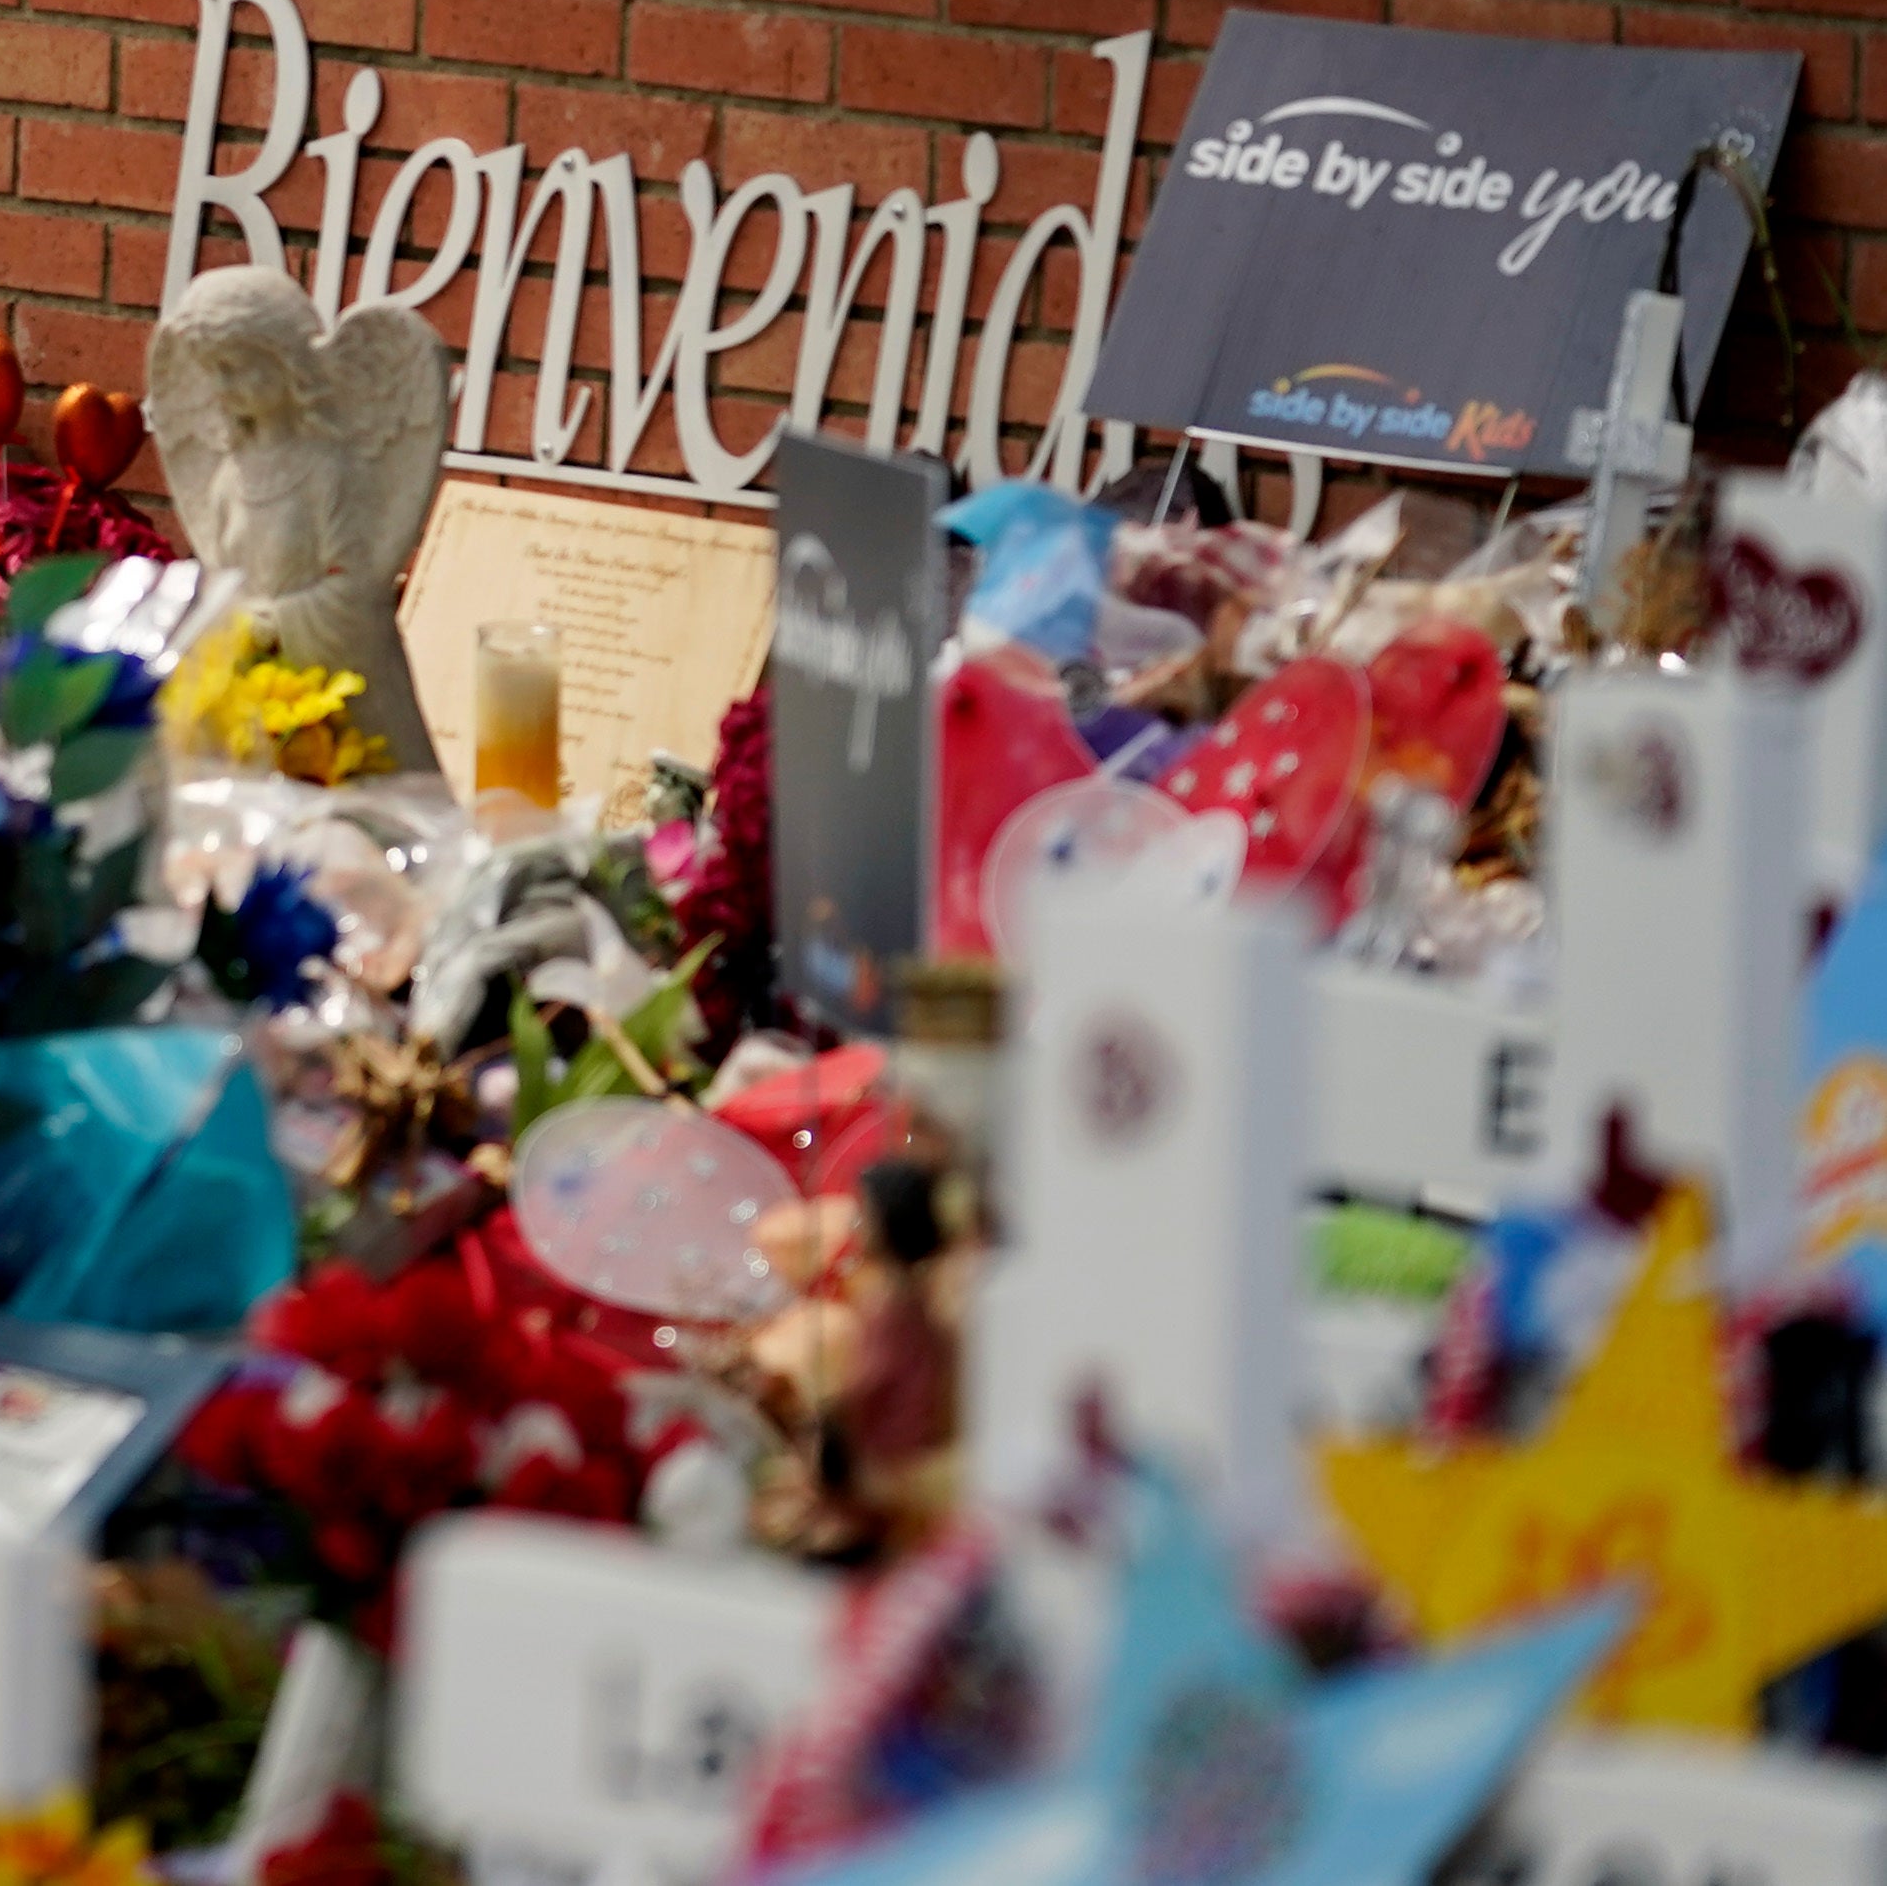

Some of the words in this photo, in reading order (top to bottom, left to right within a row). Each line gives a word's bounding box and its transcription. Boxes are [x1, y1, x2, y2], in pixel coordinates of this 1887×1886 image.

[1185, 118, 1311, 190] side
[1312, 140, 1392, 210] by
[1392, 130, 1515, 213] side
[1497, 159, 1680, 277] you
[1247, 376, 1325, 424] side
[1325, 390, 1381, 440] by
[1379, 387, 1455, 443] side
[1445, 398, 1539, 462] Kids
